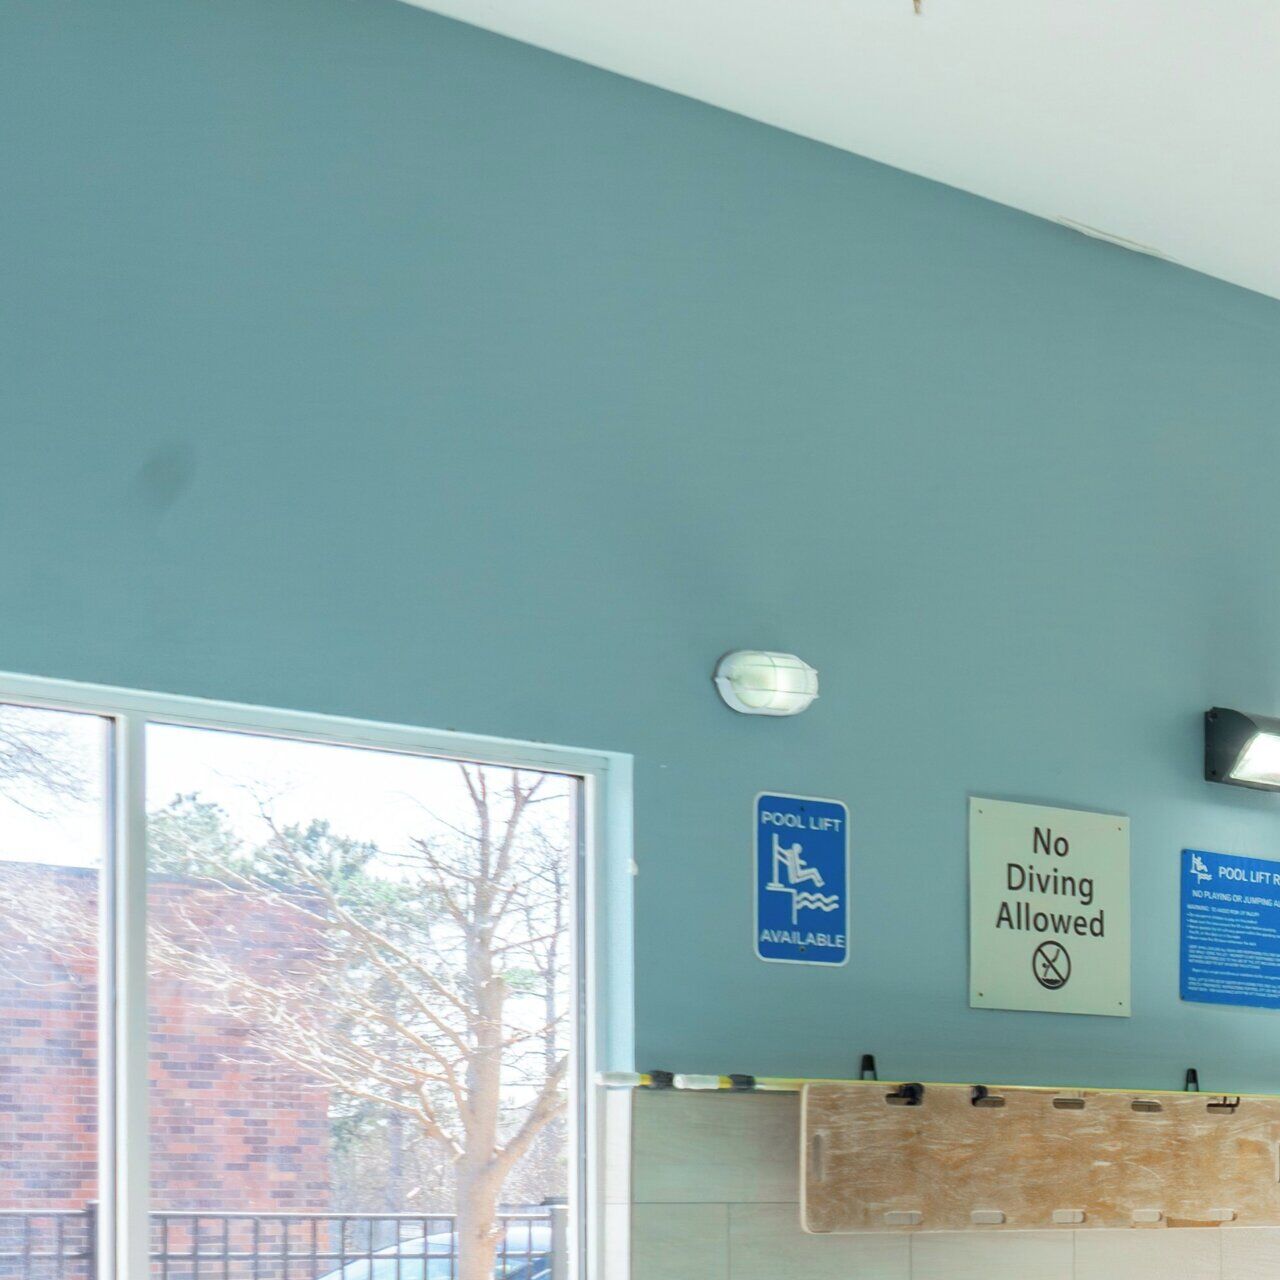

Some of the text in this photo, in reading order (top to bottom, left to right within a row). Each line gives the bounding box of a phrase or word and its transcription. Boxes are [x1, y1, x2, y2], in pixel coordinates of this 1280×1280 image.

[761, 811, 843, 833] POOL LIFT
[1032, 826, 1070, 858] No
[1006, 862, 1094, 906] Diving
[1218, 865, 1249, 882] POOL
[1250, 870, 1272, 885] LIFT
[1192, 889, 1204, 899] NO
[1204, 891, 1232, 903] PLAYING
[1232, 894, 1243, 904] OR
[1243, 895, 1273, 908] JUMPING
[995, 901, 1105, 938] Allowed
[760, 928, 846, 949] AVAILABLE
